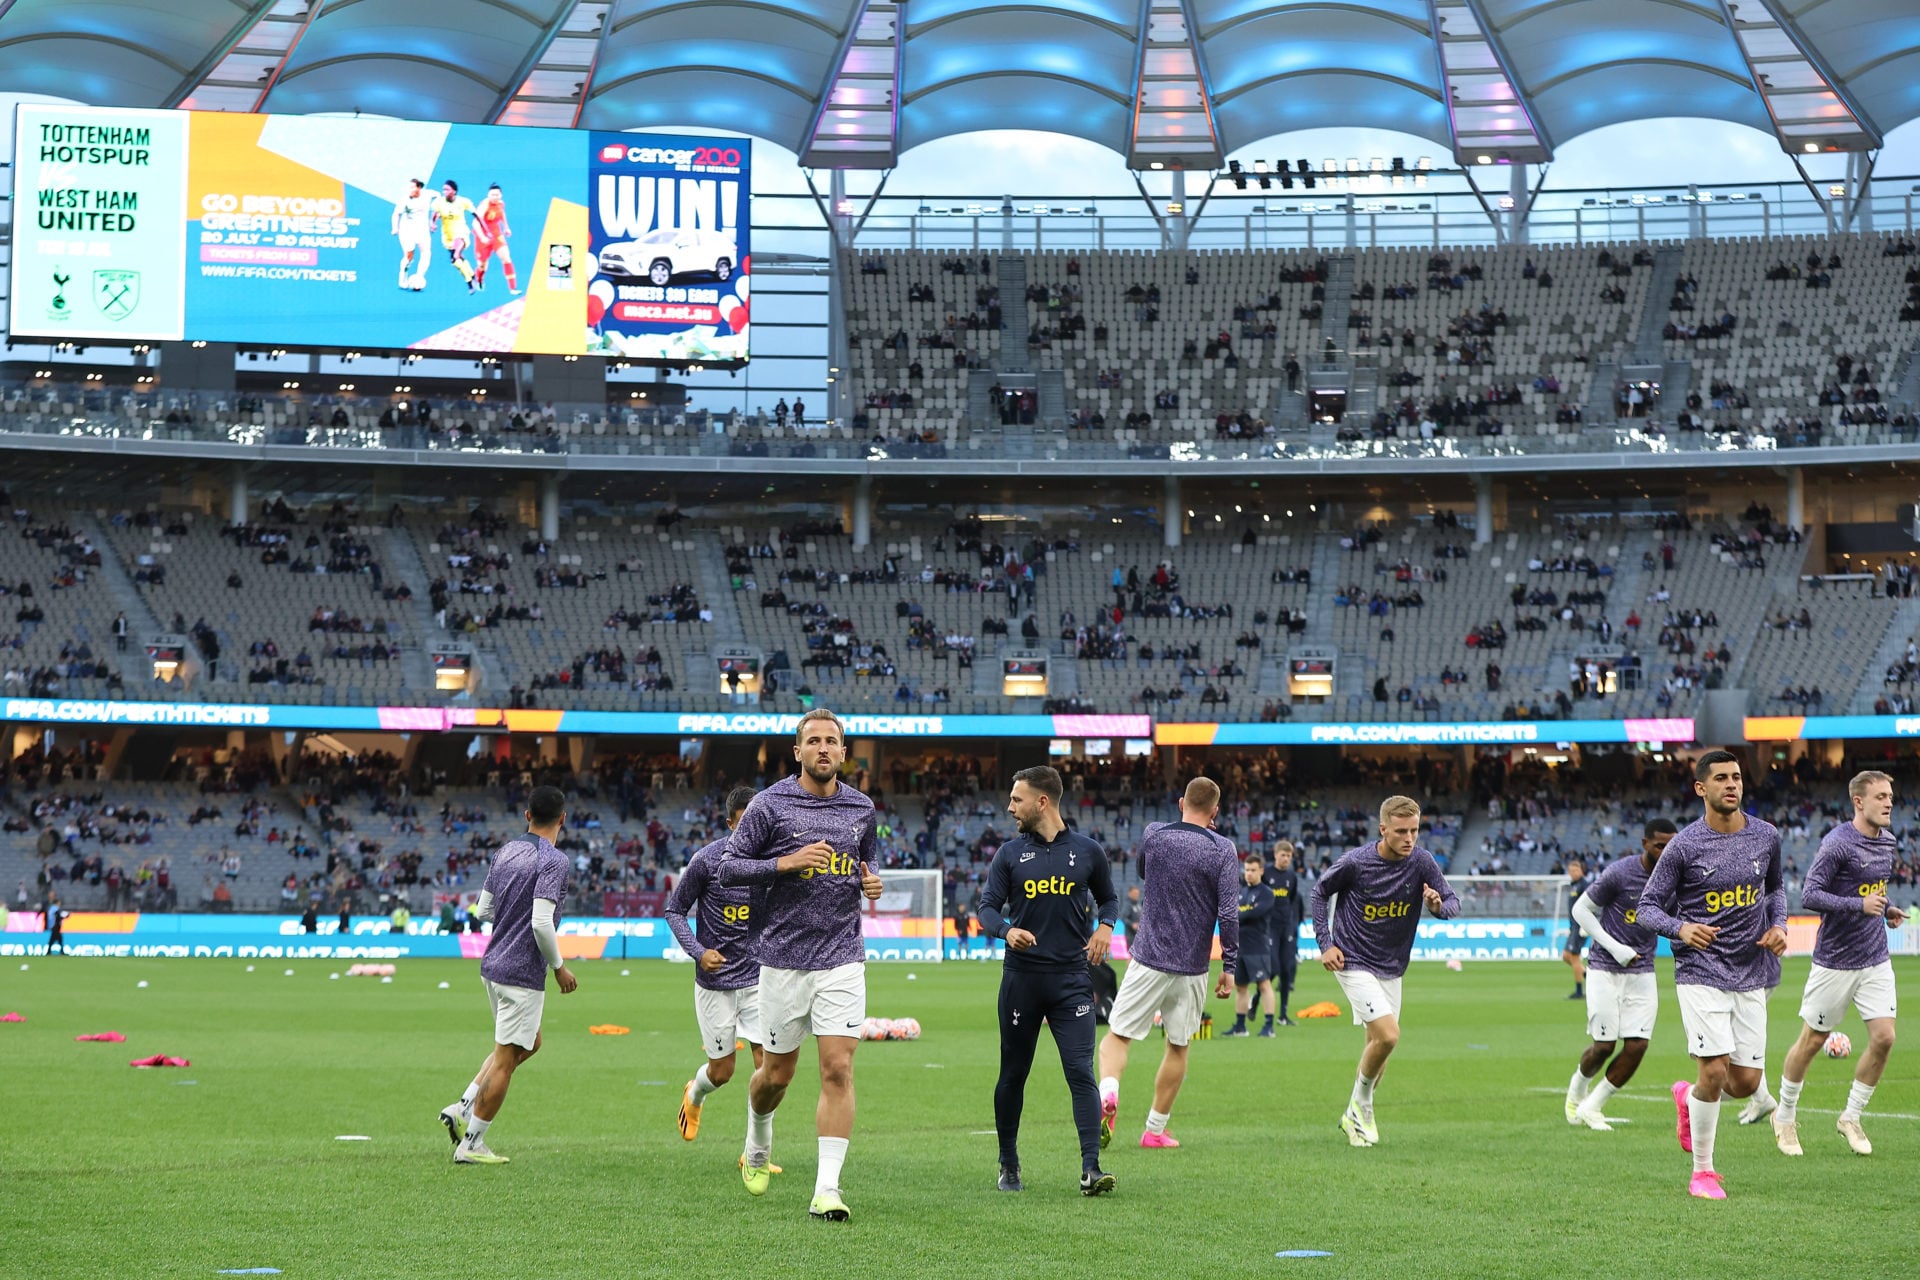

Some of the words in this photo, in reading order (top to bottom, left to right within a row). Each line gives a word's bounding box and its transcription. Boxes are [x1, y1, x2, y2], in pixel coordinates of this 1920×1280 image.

[40, 124, 150, 146] TOTTENHAM
[40, 145, 149, 166] HOTSPUR
[38, 188, 90, 208] WEST
[95, 190, 138, 211] HAM
[201, 194, 238, 212] GO
[242, 195, 343, 216] BEYOND
[598, 174, 739, 241] WIN!
[38, 210, 135, 232] UNITED
[224, 232, 261, 245] JULY
[299, 235, 359, 249] AUGUST
[201, 265, 357, 283] WWW.FIFA.COM/TICKETS
[6, 699, 270, 724] FIFA.COM/PERTHTICKETS
[1311, 724, 1538, 741] FIFA.COM/PERTHTICKETS
[1023, 875, 1076, 899] getir
[1363, 901, 1411, 922] getir
